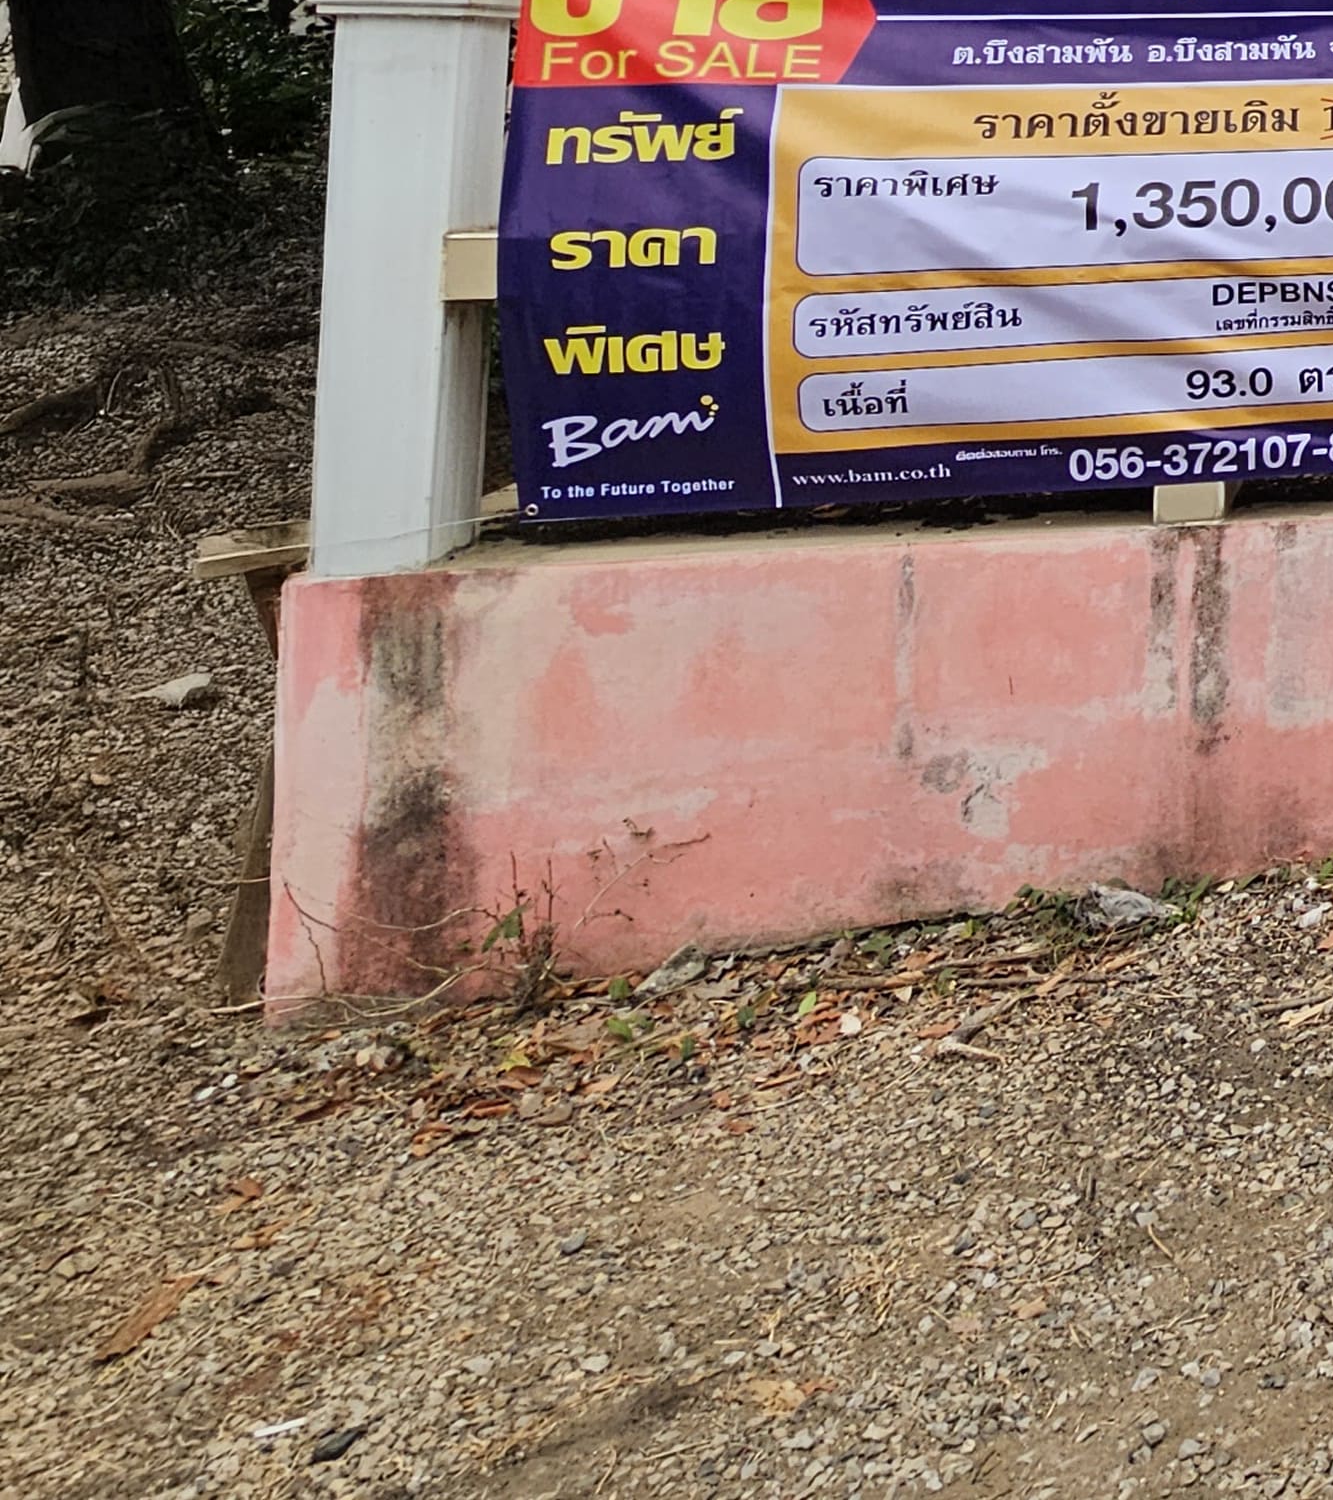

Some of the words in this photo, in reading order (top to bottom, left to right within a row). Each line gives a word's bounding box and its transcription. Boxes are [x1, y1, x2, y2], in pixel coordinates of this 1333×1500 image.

[542, 41, 637, 81] For
[654, 40, 822, 80] SALE
[952, 37, 1133, 65] ต.บึงสามพัน
[1147, 34, 1316, 63] อ.บึงสามพัน
[973, 91, 1300, 140] ราคาตั้งขายเดิม
[546, 108, 743, 165] ทรัพย์
[813, 169, 1000, 198] ราคาพิเศษ
[550, 227, 716, 270] ราคา
[809, 301, 1023, 338] รหัสทรัพย์สิน
[544, 325, 726, 375] พิเศษ
[822, 379, 909, 417] เนื้อที่
[1186, 367, 1274, 400] 93.0
[541, 408, 716, 468] Bam
[541, 486, 562, 499] To
[568, 484, 595, 498] the
[601, 482, 655, 496] Future
[661, 479, 735, 496] Together
[791, 463, 951, 486] www.bam.co.th
